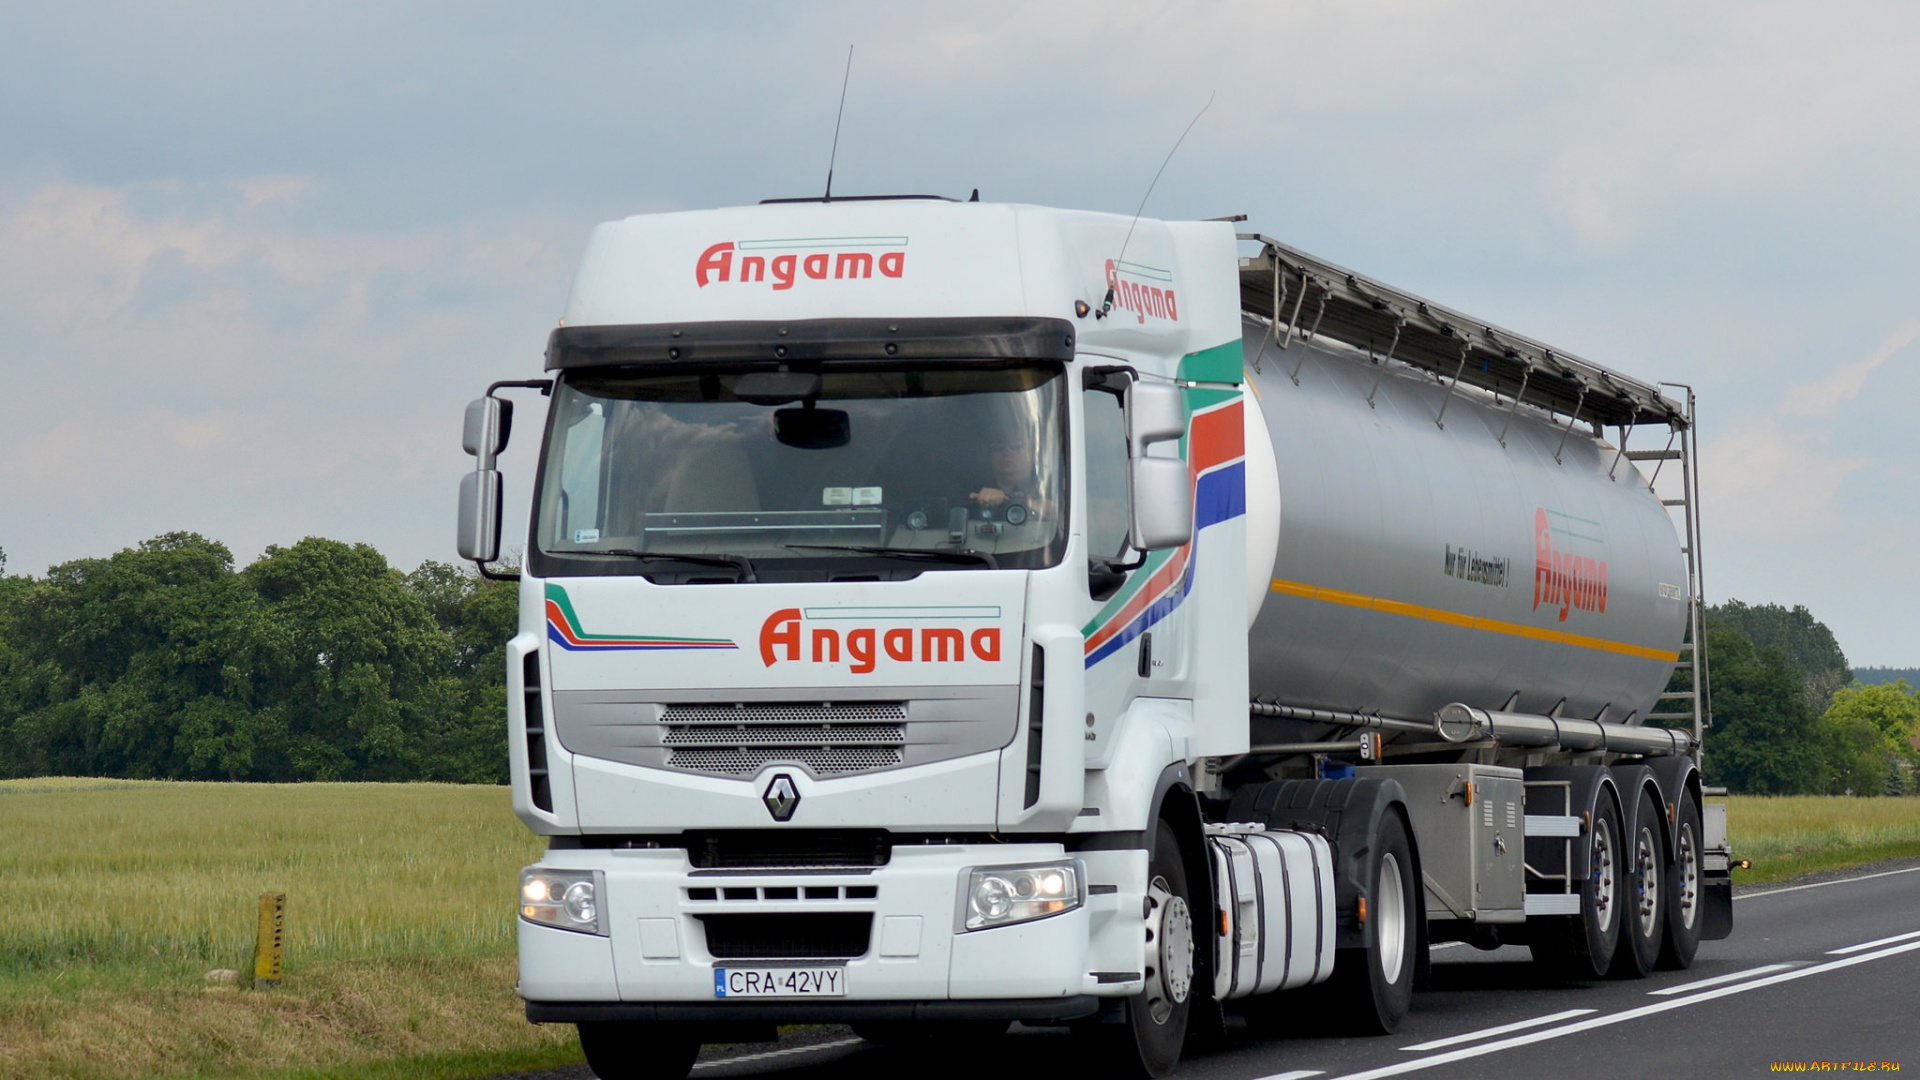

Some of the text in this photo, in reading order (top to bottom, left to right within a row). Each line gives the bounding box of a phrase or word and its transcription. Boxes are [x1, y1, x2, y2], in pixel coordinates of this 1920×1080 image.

[696, 241, 905, 290] Angama
[1105, 258, 1178, 324] Angama
[1444, 543, 1456, 577] Nur
[1533, 507, 1608, 622] Angama
[759, 608, 1001, 673] Angama
[729, 970, 838, 993] CRA 42VY
